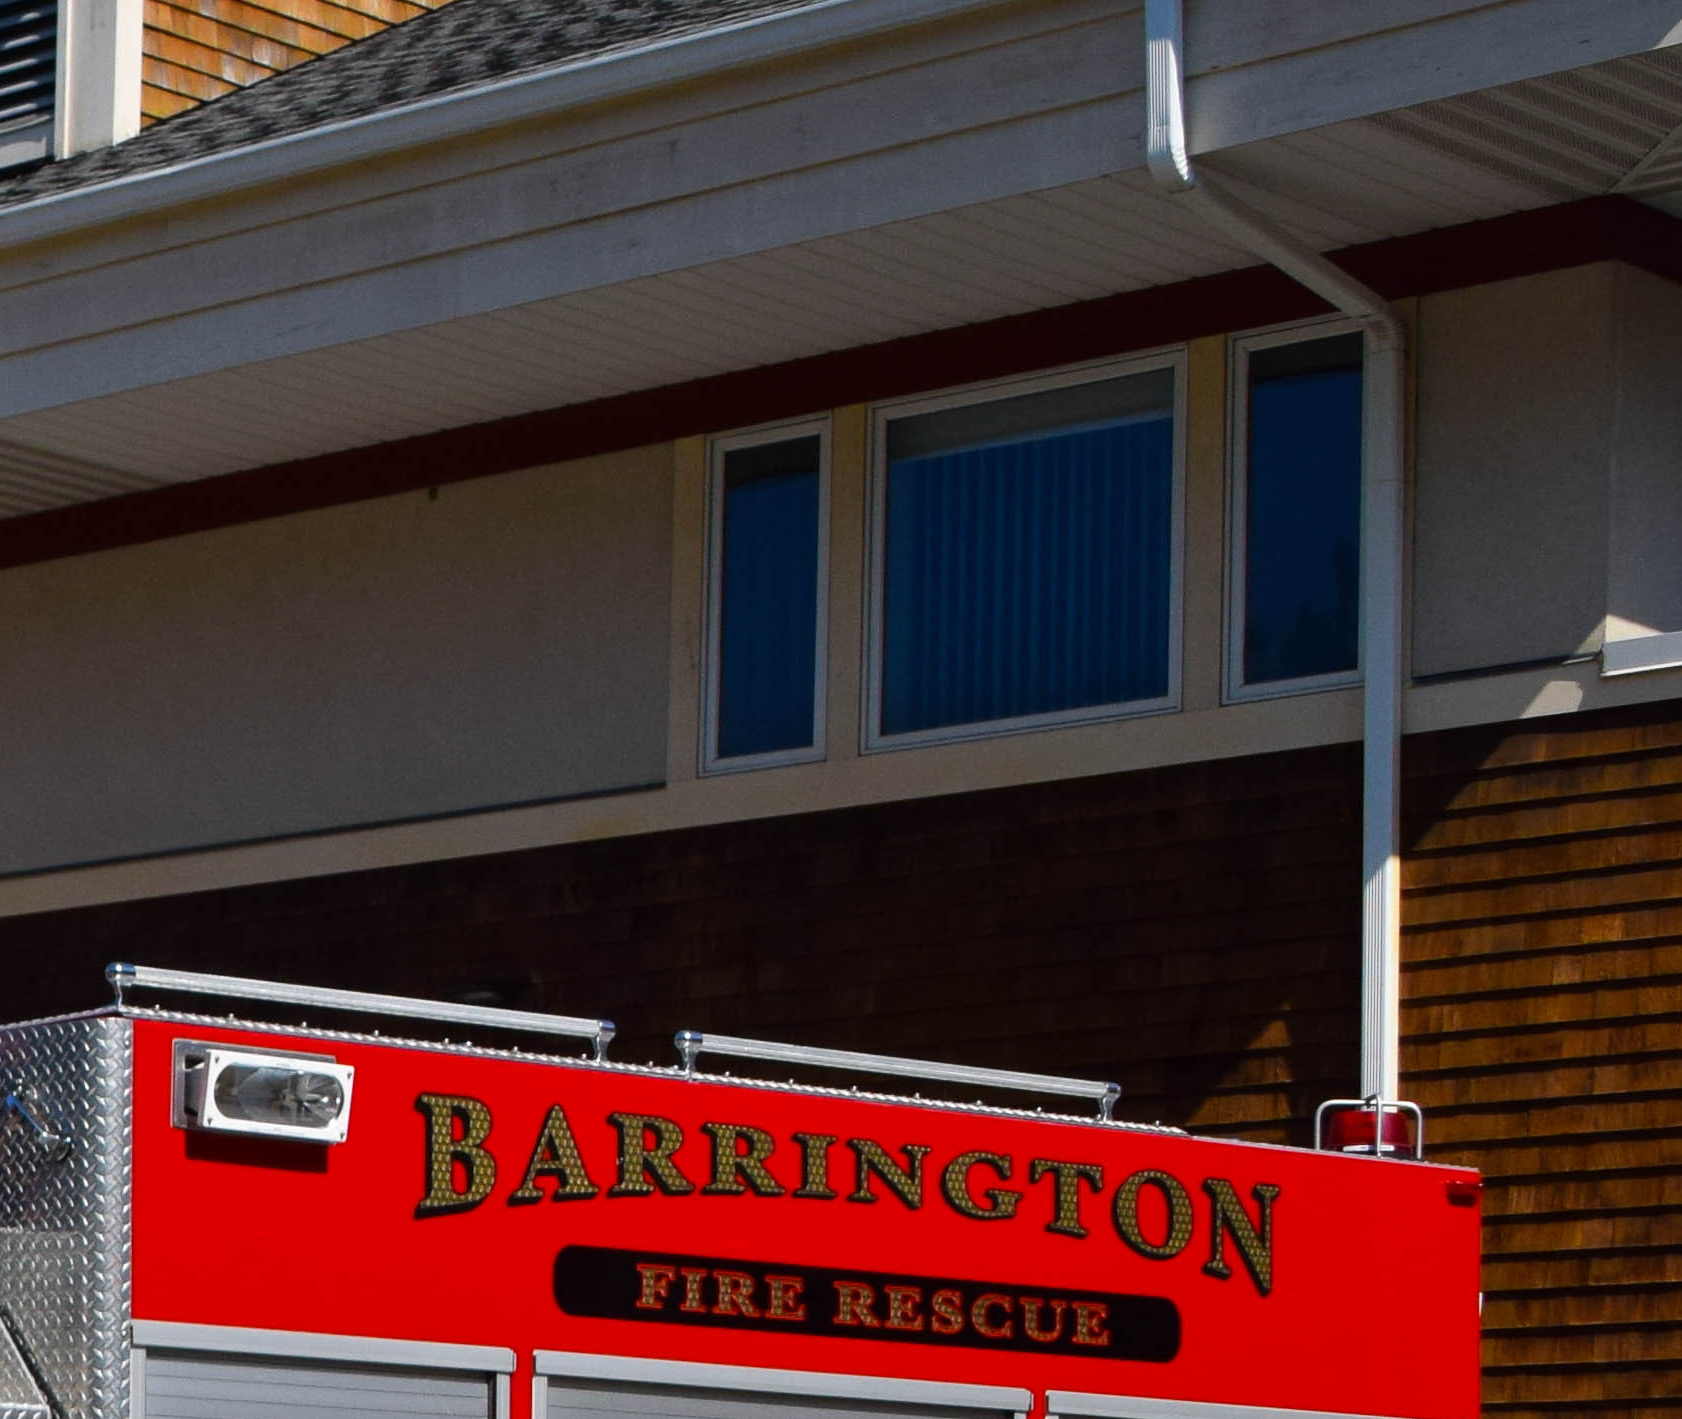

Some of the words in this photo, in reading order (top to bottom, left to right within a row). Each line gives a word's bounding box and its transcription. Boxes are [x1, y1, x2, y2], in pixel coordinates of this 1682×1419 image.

[413, 1092, 1281, 1297] BARRINGTON
[635, 1262, 808, 1323] FIRE
[833, 1280, 1111, 1348] RESCUE
